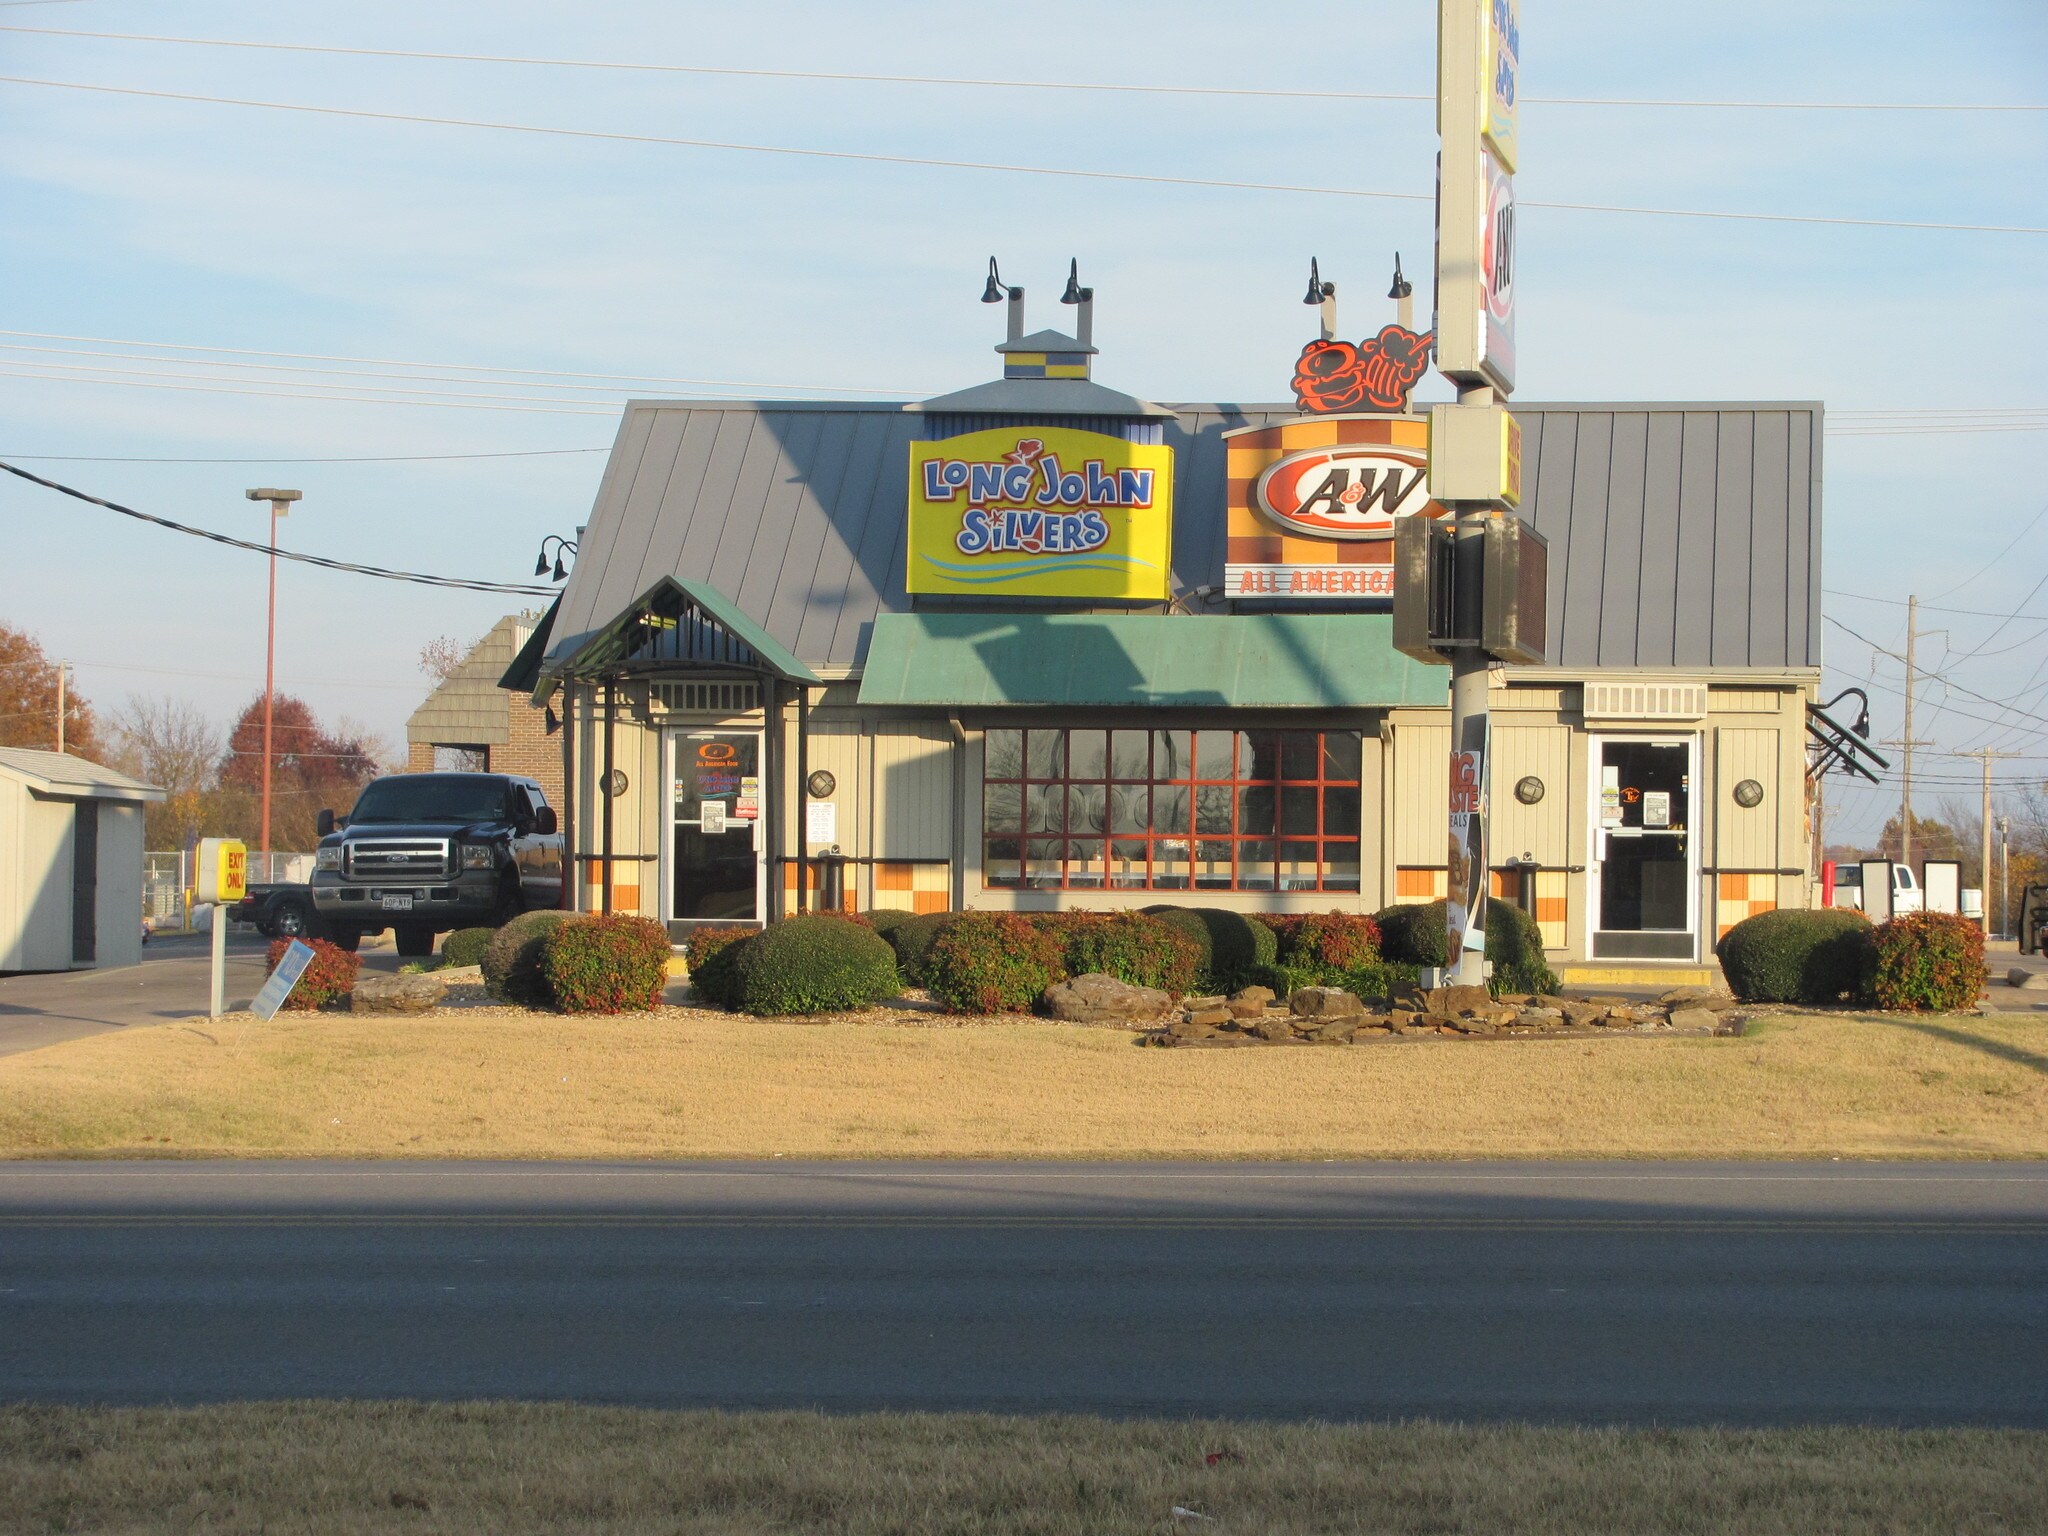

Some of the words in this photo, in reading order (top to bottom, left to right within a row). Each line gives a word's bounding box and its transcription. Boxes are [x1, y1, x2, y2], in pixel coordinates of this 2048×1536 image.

[922, 458, 1037, 505] LONG
[1294, 467, 1427, 515] A&W
[1240, 570, 1280, 594] ALL
[1450, 752, 1475, 786] IG
[228, 852, 244, 869] EXIT
[227, 872, 245, 889] ONLY
